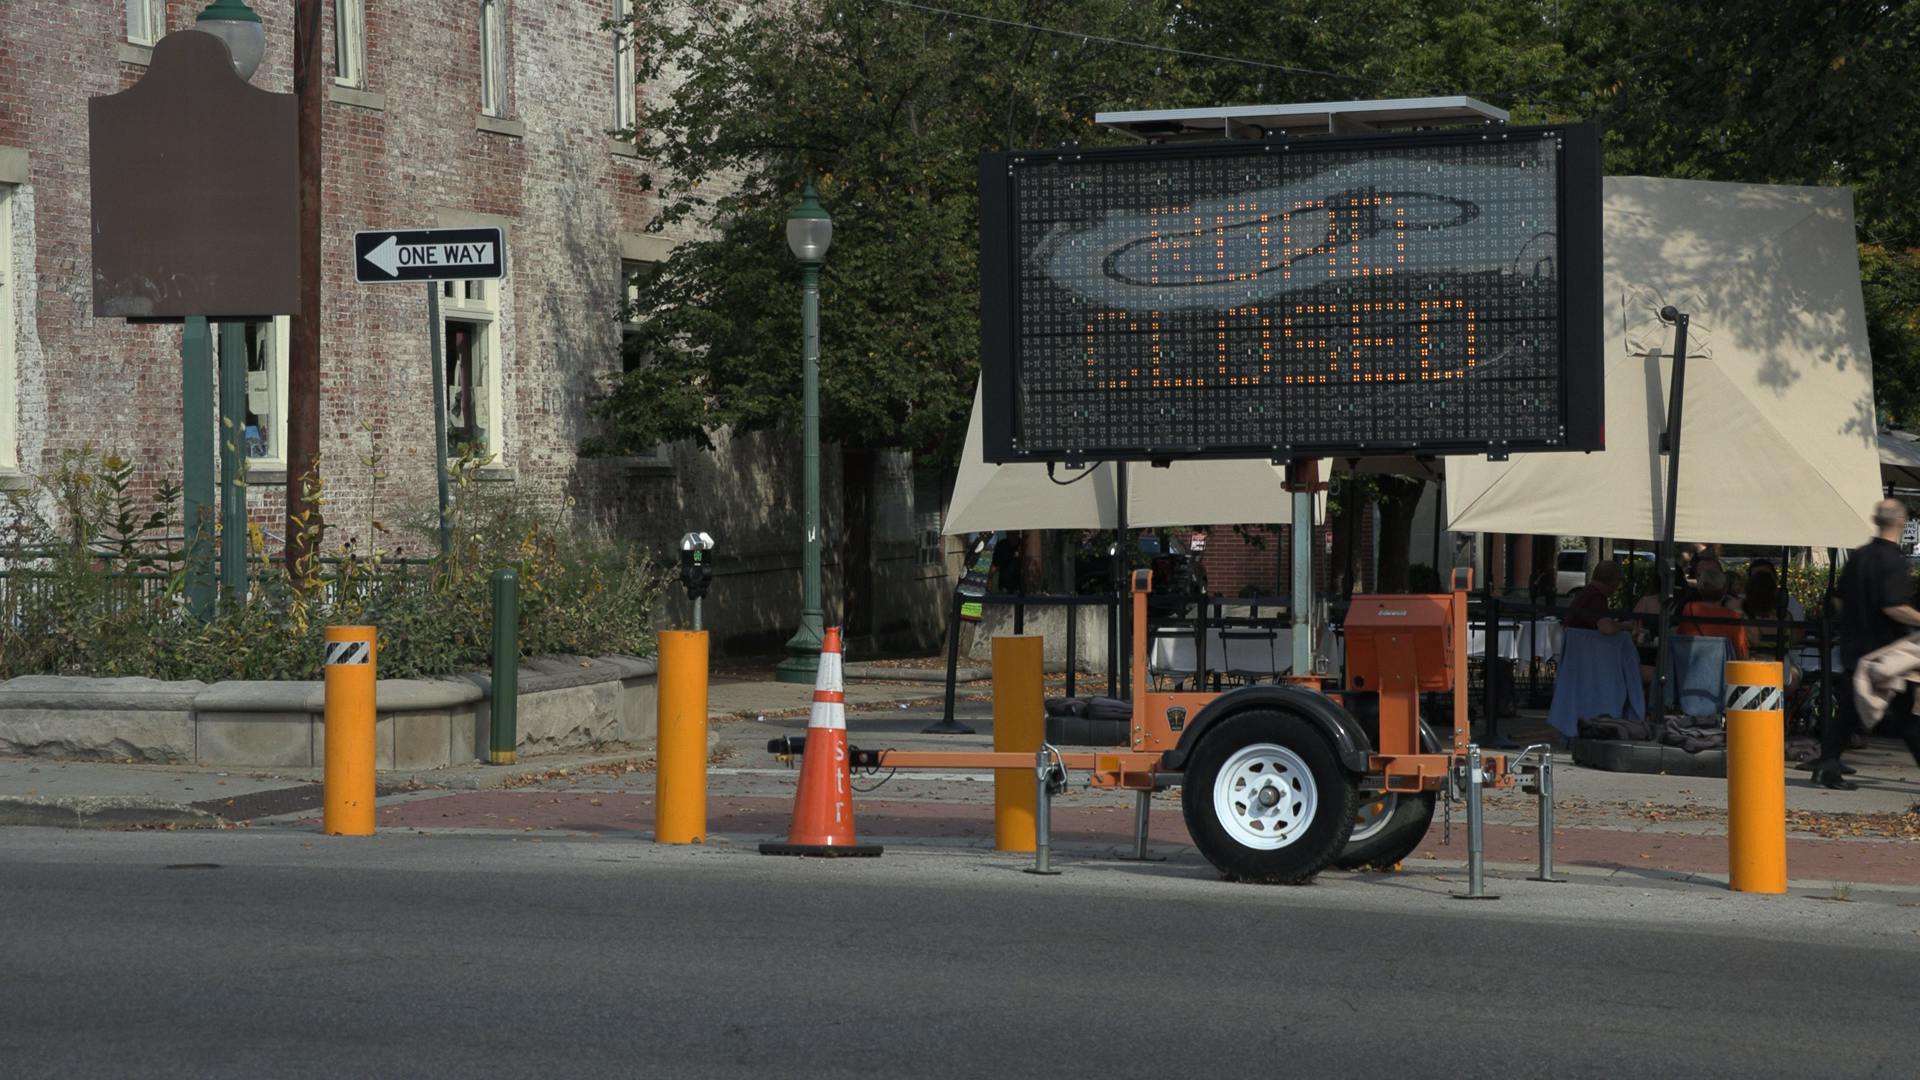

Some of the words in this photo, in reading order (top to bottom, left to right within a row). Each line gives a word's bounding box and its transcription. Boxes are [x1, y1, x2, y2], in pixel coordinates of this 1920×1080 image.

[398, 246, 438, 265] ONE
[444, 244, 487, 263] WAY
[1151, 198, 1405, 284] ROAD
[1086, 299, 1476, 388] CLOSED
